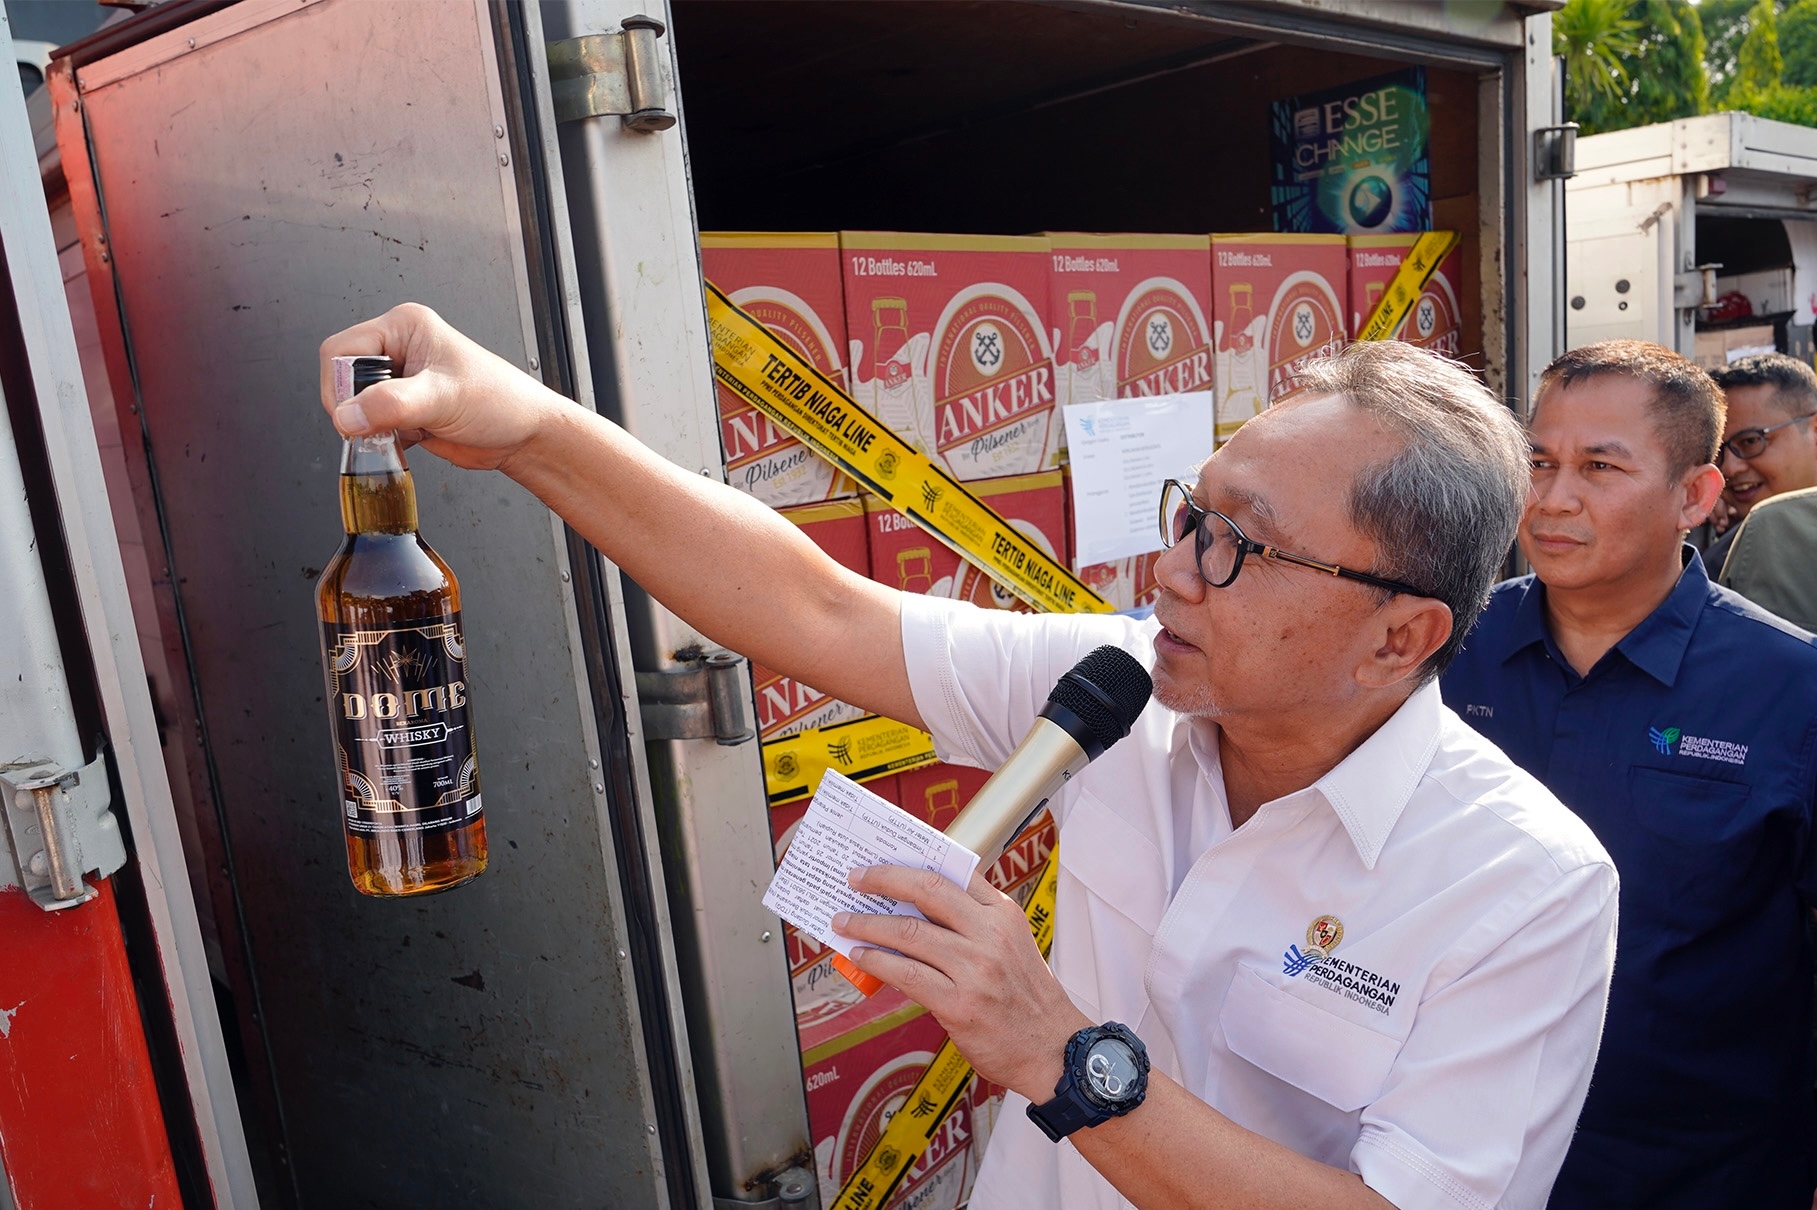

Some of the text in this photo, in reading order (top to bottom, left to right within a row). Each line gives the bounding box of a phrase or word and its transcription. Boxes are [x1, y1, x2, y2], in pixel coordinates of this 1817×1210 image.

[1324, 88, 1398, 134] ESSE
[1296, 125, 1399, 166] CHANGE
[852, 257, 938, 276] 12 Bottles 620mL
[1053, 256, 1064, 272] 12
[1065, 256, 1094, 272] Bottles
[1218, 252, 1227, 266] 12
[1228, 252, 1251, 266] Bottles
[979, 302, 1009, 313] QUALITY
[708, 318, 755, 356] ENTERIAN
[710, 329, 750, 362] AGANGAN
[740, 387, 784, 421] PERDAGANGAN
[760, 353, 876, 453] TERTIB NIAGA LINE
[770, 388, 804, 416] PERDAGANGAN
[938, 367, 1053, 446] ANKER
[971, 423, 1026, 462] Pilsener
[878, 514, 892, 533] 12
[990, 532, 1025, 569] TERTIB
[1024, 561, 1052, 593] NIAGA
[1051, 580, 1076, 608] LINE
[1466, 704, 1494, 717] PKTN
[384, 728, 440, 744] WHISKY
[857, 727, 909, 746] KEMENTERIAN
[858, 735, 910, 754] PERDAGANGAN
[1682, 735, 1748, 753] KEMENTERIAN
[1680, 742, 1745, 759] PERDAGANGAN
[825, 778, 859, 801] Tidak memiliki
[820, 789, 854, 812] Tidak memiliki
[828, 808, 844, 819] Jenis
[836, 831, 849, 842] Juta
[860, 812, 926, 854] Timbangan Duduk (UTTP)
[886, 813, 930, 844] Meter Air (UTTP)
[807, 834, 821, 845] 2021
[847, 838, 864, 851] Ratus
[874, 835, 898, 851] Komoditi
[797, 839, 843, 867] Nomor 25 Tahun
[821, 842, 840, 856] Tahun
[824, 834, 873, 865] tersebut dilakukan
[840, 852, 849, 860] 20
[863, 847, 879, 859] (Lima
[990, 825, 1053, 890] ANK
[798, 858, 810, 867] tata
[807, 853, 831, 870] Importir
[925, 864, 935, 872] No
[782, 866, 807, 884] generasi
[804, 870, 822, 883] dapat
[810, 863, 846, 887] pemeriksaan
[829, 865, 847, 878] (lima)
[773, 881, 791, 895] bidang
[805, 879, 820, 891] pada
[821, 878, 836, 890] yang
[775, 893, 800, 910] Berusaha
[793, 894, 810, 906] daftar
[804, 890, 819, 902] KBLI
[818, 886, 838, 902] terjadi
[835, 887, 856, 901] agresif
[858, 889, 894, 914] Pengawasan
[818, 897, 839, 912] dengan
[835, 897, 851, 909] akan
[854, 898, 879, 915] tindakan
[789, 909, 810, 925] Gudang
[812, 914, 829, 927] Nomor
[807, 922, 825, 935] Daftar
[1320, 957, 1400, 995] EMENTERIAN
[1309, 964, 1395, 1006] PERDAGANGAN
[1304, 973, 1390, 1016] REPUBLIK INDONESIA
[806, 1066, 840, 1092] 620mL
